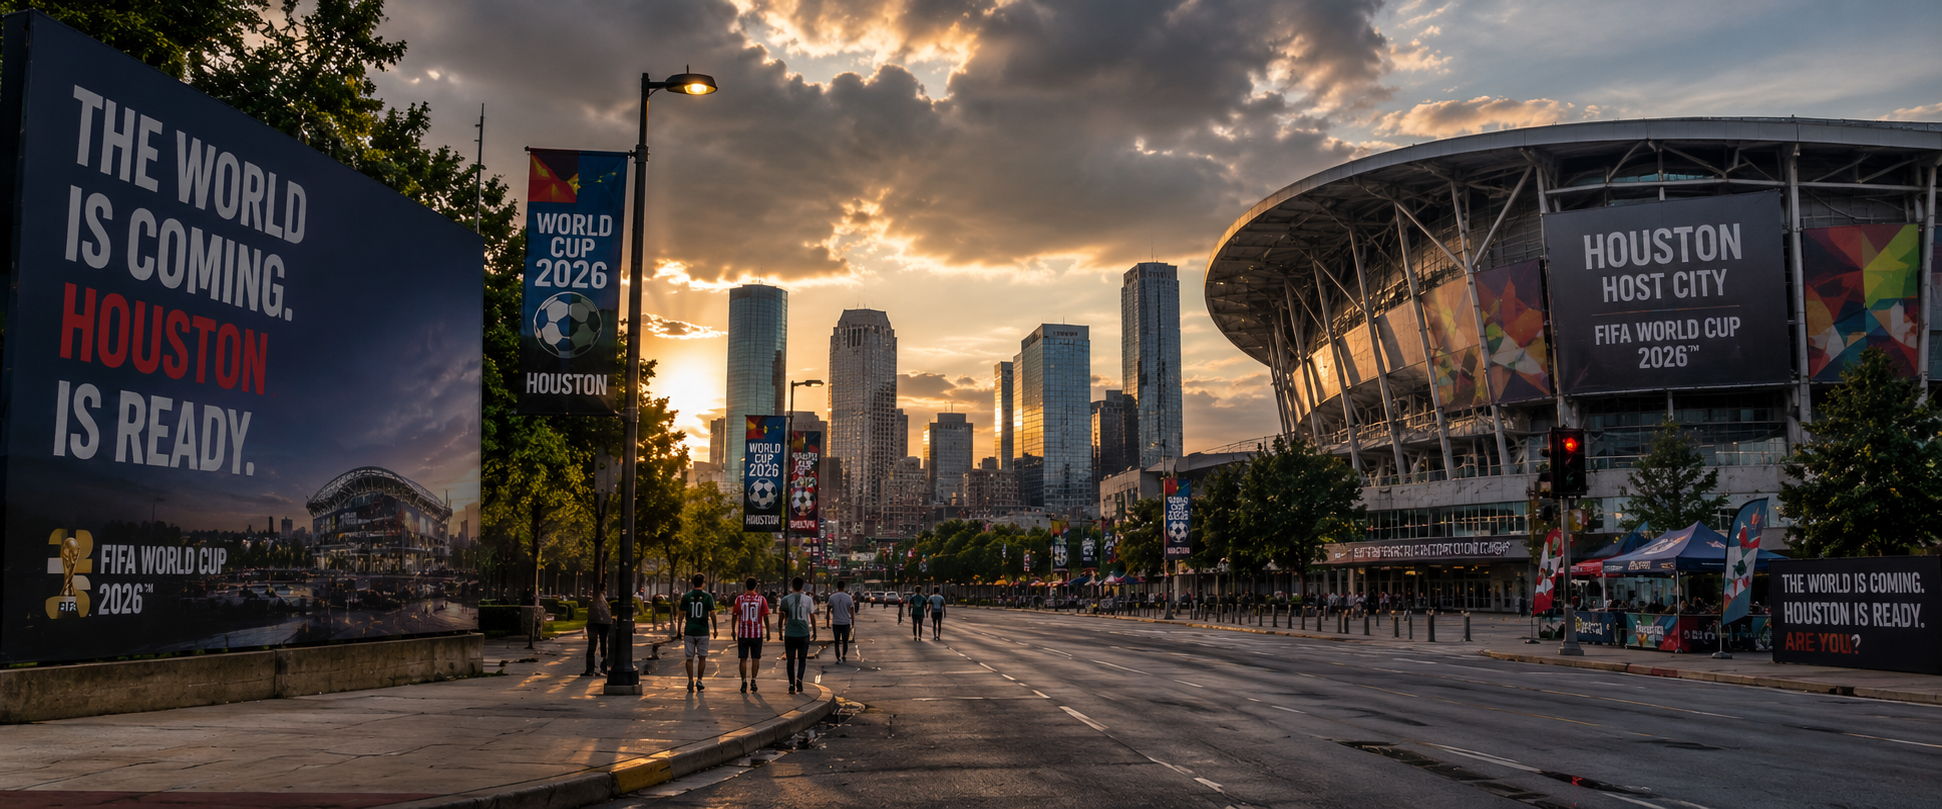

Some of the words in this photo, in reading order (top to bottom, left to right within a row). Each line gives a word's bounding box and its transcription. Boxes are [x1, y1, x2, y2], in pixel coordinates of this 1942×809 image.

[73, 85, 163, 192] THE
[176, 130, 307, 244] WORLD
[536, 212, 613, 237] WORLD
[65, 185, 114, 269] IS
[127, 207, 294, 322] COMING.
[550, 236, 596, 259] CUP
[1584, 223, 1742, 270] HOUSTON
[534, 258, 608, 290] 2026
[1602, 272, 1665, 303] HOST
[1672, 268, 1728, 299] CITY
[59, 282, 269, 396] HOUSTON
[1594, 323, 1632, 346] FIFA
[1635, 319, 1699, 342] WORLD
[1704, 316, 1741, 339] CUP
[525, 372, 608, 396] HOUSTON
[53, 380, 101, 460] IS
[115, 389, 256, 477] READY.
[749, 442, 781, 454] WORLD
[754, 454, 774, 466] CUP
[749, 463, 779, 477] 2026
[100, 544, 136, 575] FIFA
[141, 545, 195, 575] WORLD
[198, 547, 228, 575] CUP
[1781, 573, 1805, 594] THE
[1807, 572, 1851, 594] WORLD
[1854, 572, 1867, 594] IS
[1869, 571, 1925, 594] COMING.
[690, 601, 703, 619] 10
[1783, 601, 1850, 626] HOUSTON
[1854, 601, 1869, 626] IS
[1873, 602, 1926, 629] READY.
[1784, 631, 1815, 652] ARE
[1818, 632, 1862, 655] YOU?
